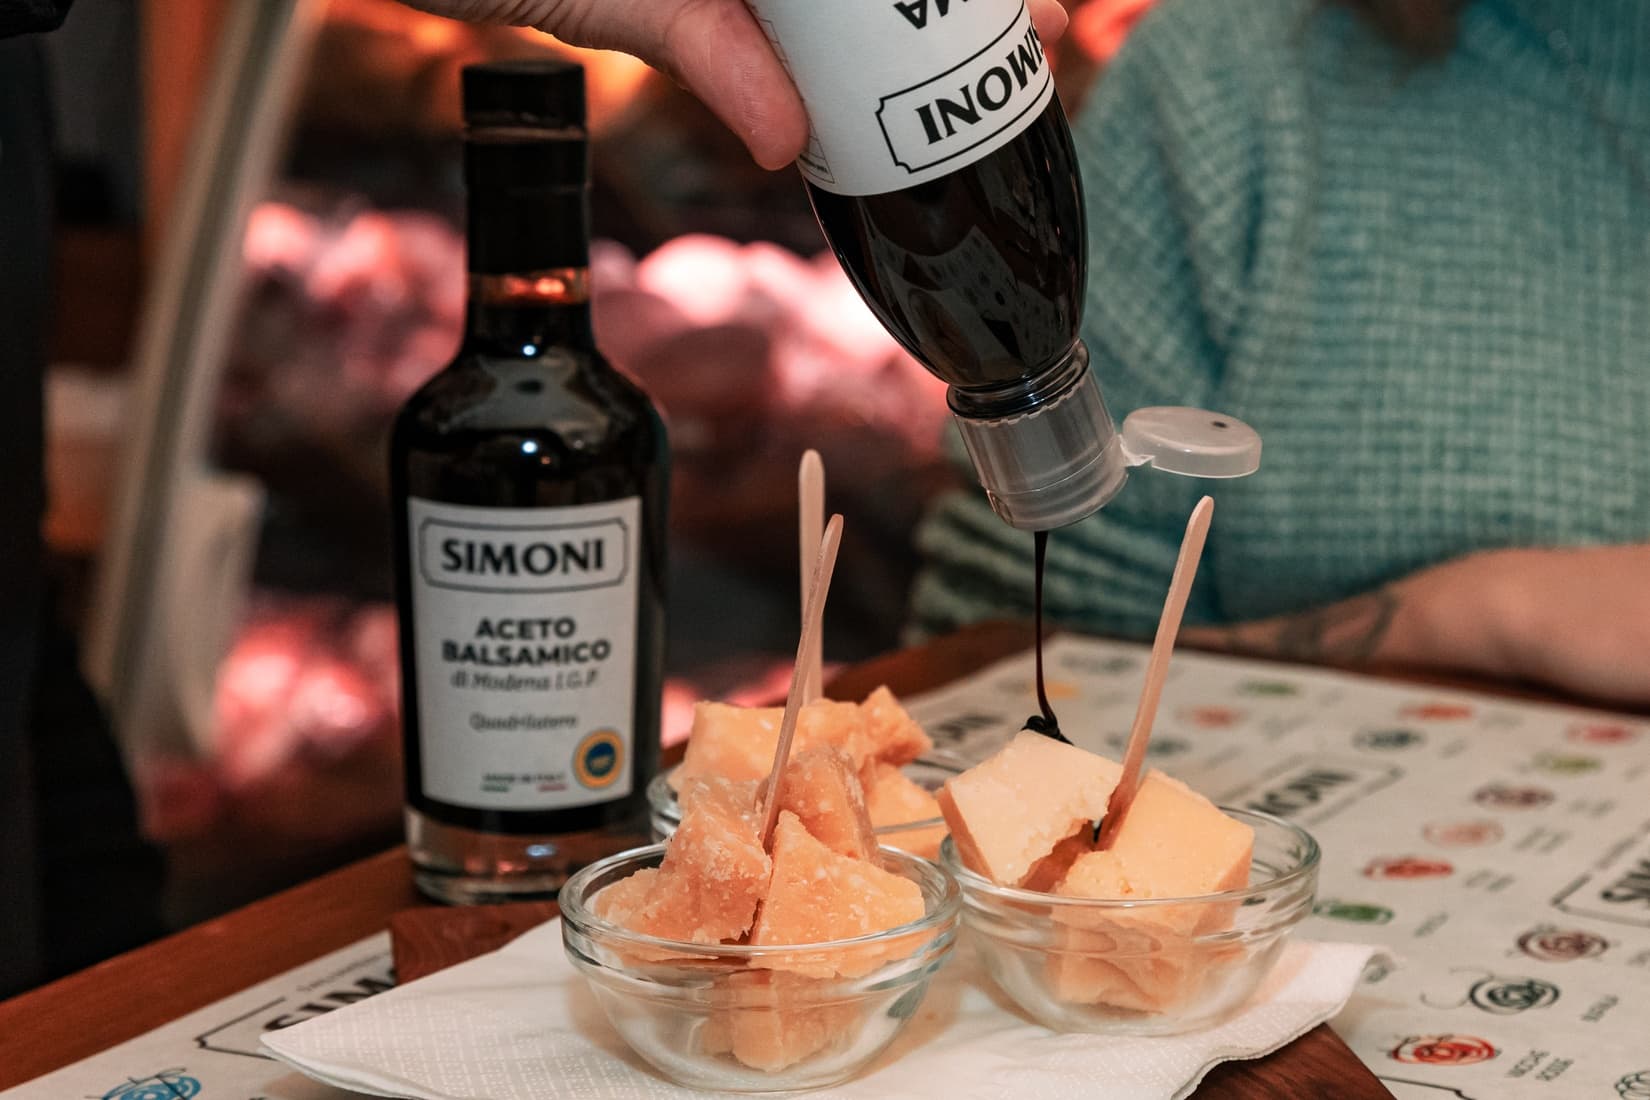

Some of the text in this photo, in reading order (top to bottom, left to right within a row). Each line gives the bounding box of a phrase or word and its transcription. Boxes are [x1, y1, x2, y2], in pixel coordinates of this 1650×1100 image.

[442, 537, 604, 575] SIMONI
[475, 617, 576, 640] ACETO
[441, 640, 611, 666] BALSAMICO
[471, 673, 551, 691] Modena
